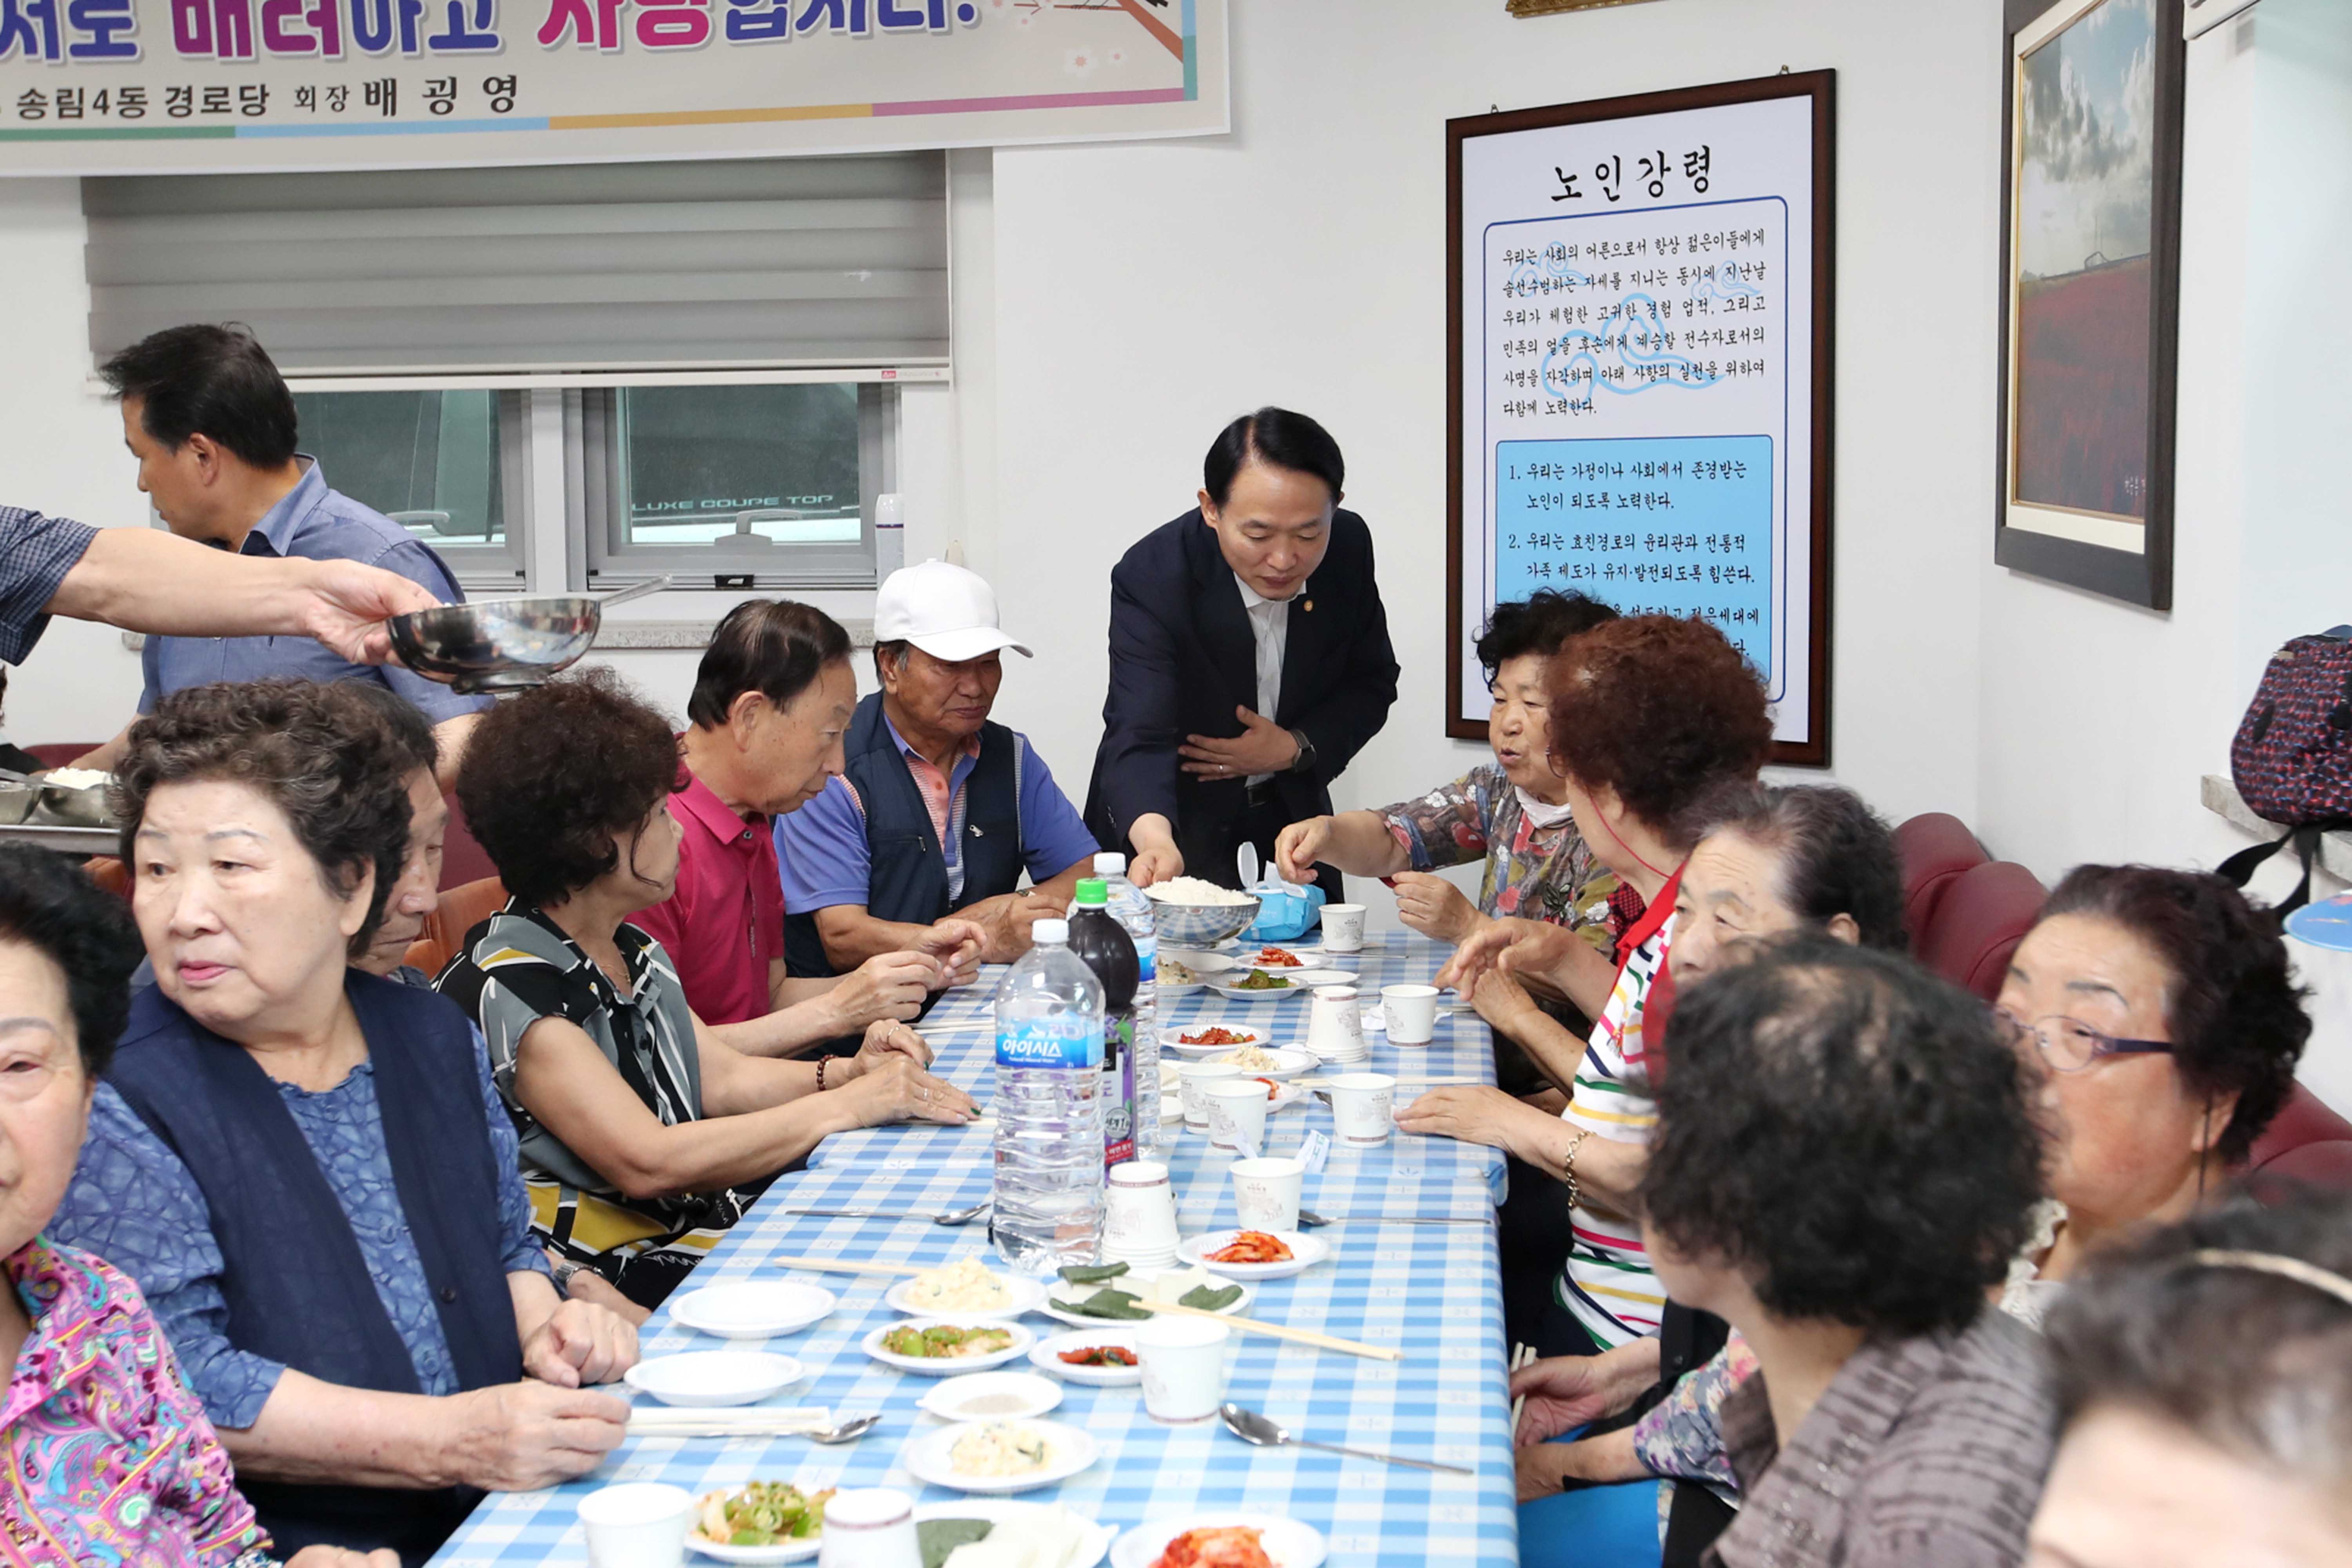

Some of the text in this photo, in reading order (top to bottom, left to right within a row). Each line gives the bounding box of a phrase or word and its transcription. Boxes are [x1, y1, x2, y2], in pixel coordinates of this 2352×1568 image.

[17, 87, 149, 120] 송림4동
[165, 83, 270, 118] 경로당
[294, 85, 350, 113] 회장
[1503, 228, 1764, 267] 우리는 사회의 어른으로서 항상 젊은이들에게
[1503, 260, 1766, 298] 솔선수범하는 자세를 지니는 동시에 지난날
[1503, 308, 1541, 328] 우리가
[1549, 305, 1588, 325] 체험한
[1597, 302, 1637, 321] 고귀한
[1646, 299, 1671, 320] 경험
[1723, 294, 1766, 314] 그리고
[1503, 326, 1764, 358] 민족의 얼을 후손에게 계승할 전수자로서의
[1503, 358, 1764, 388] 사명을 자각하며 아래 사항의 실천을 위하여
[1503, 397, 1597, 417] 다함께 노력한다.
[1510, 460, 1747, 481] 1. 우리는 가정이나 사회에서 존경받는
[786, 495, 834, 505] TOP
[1527, 492, 1674, 511] 노인이 되도록 노력한다.
[1508, 532, 1745, 554] 2. 우리는 효친경로의 윤리관과 전통적
[1527, 561, 1551, 580] 가족
[1558, 561, 1597, 580] 제도가
[1708, 564, 1755, 584] 힘쓴다.
[1002, 1039, 1062, 1057] 아이시스
